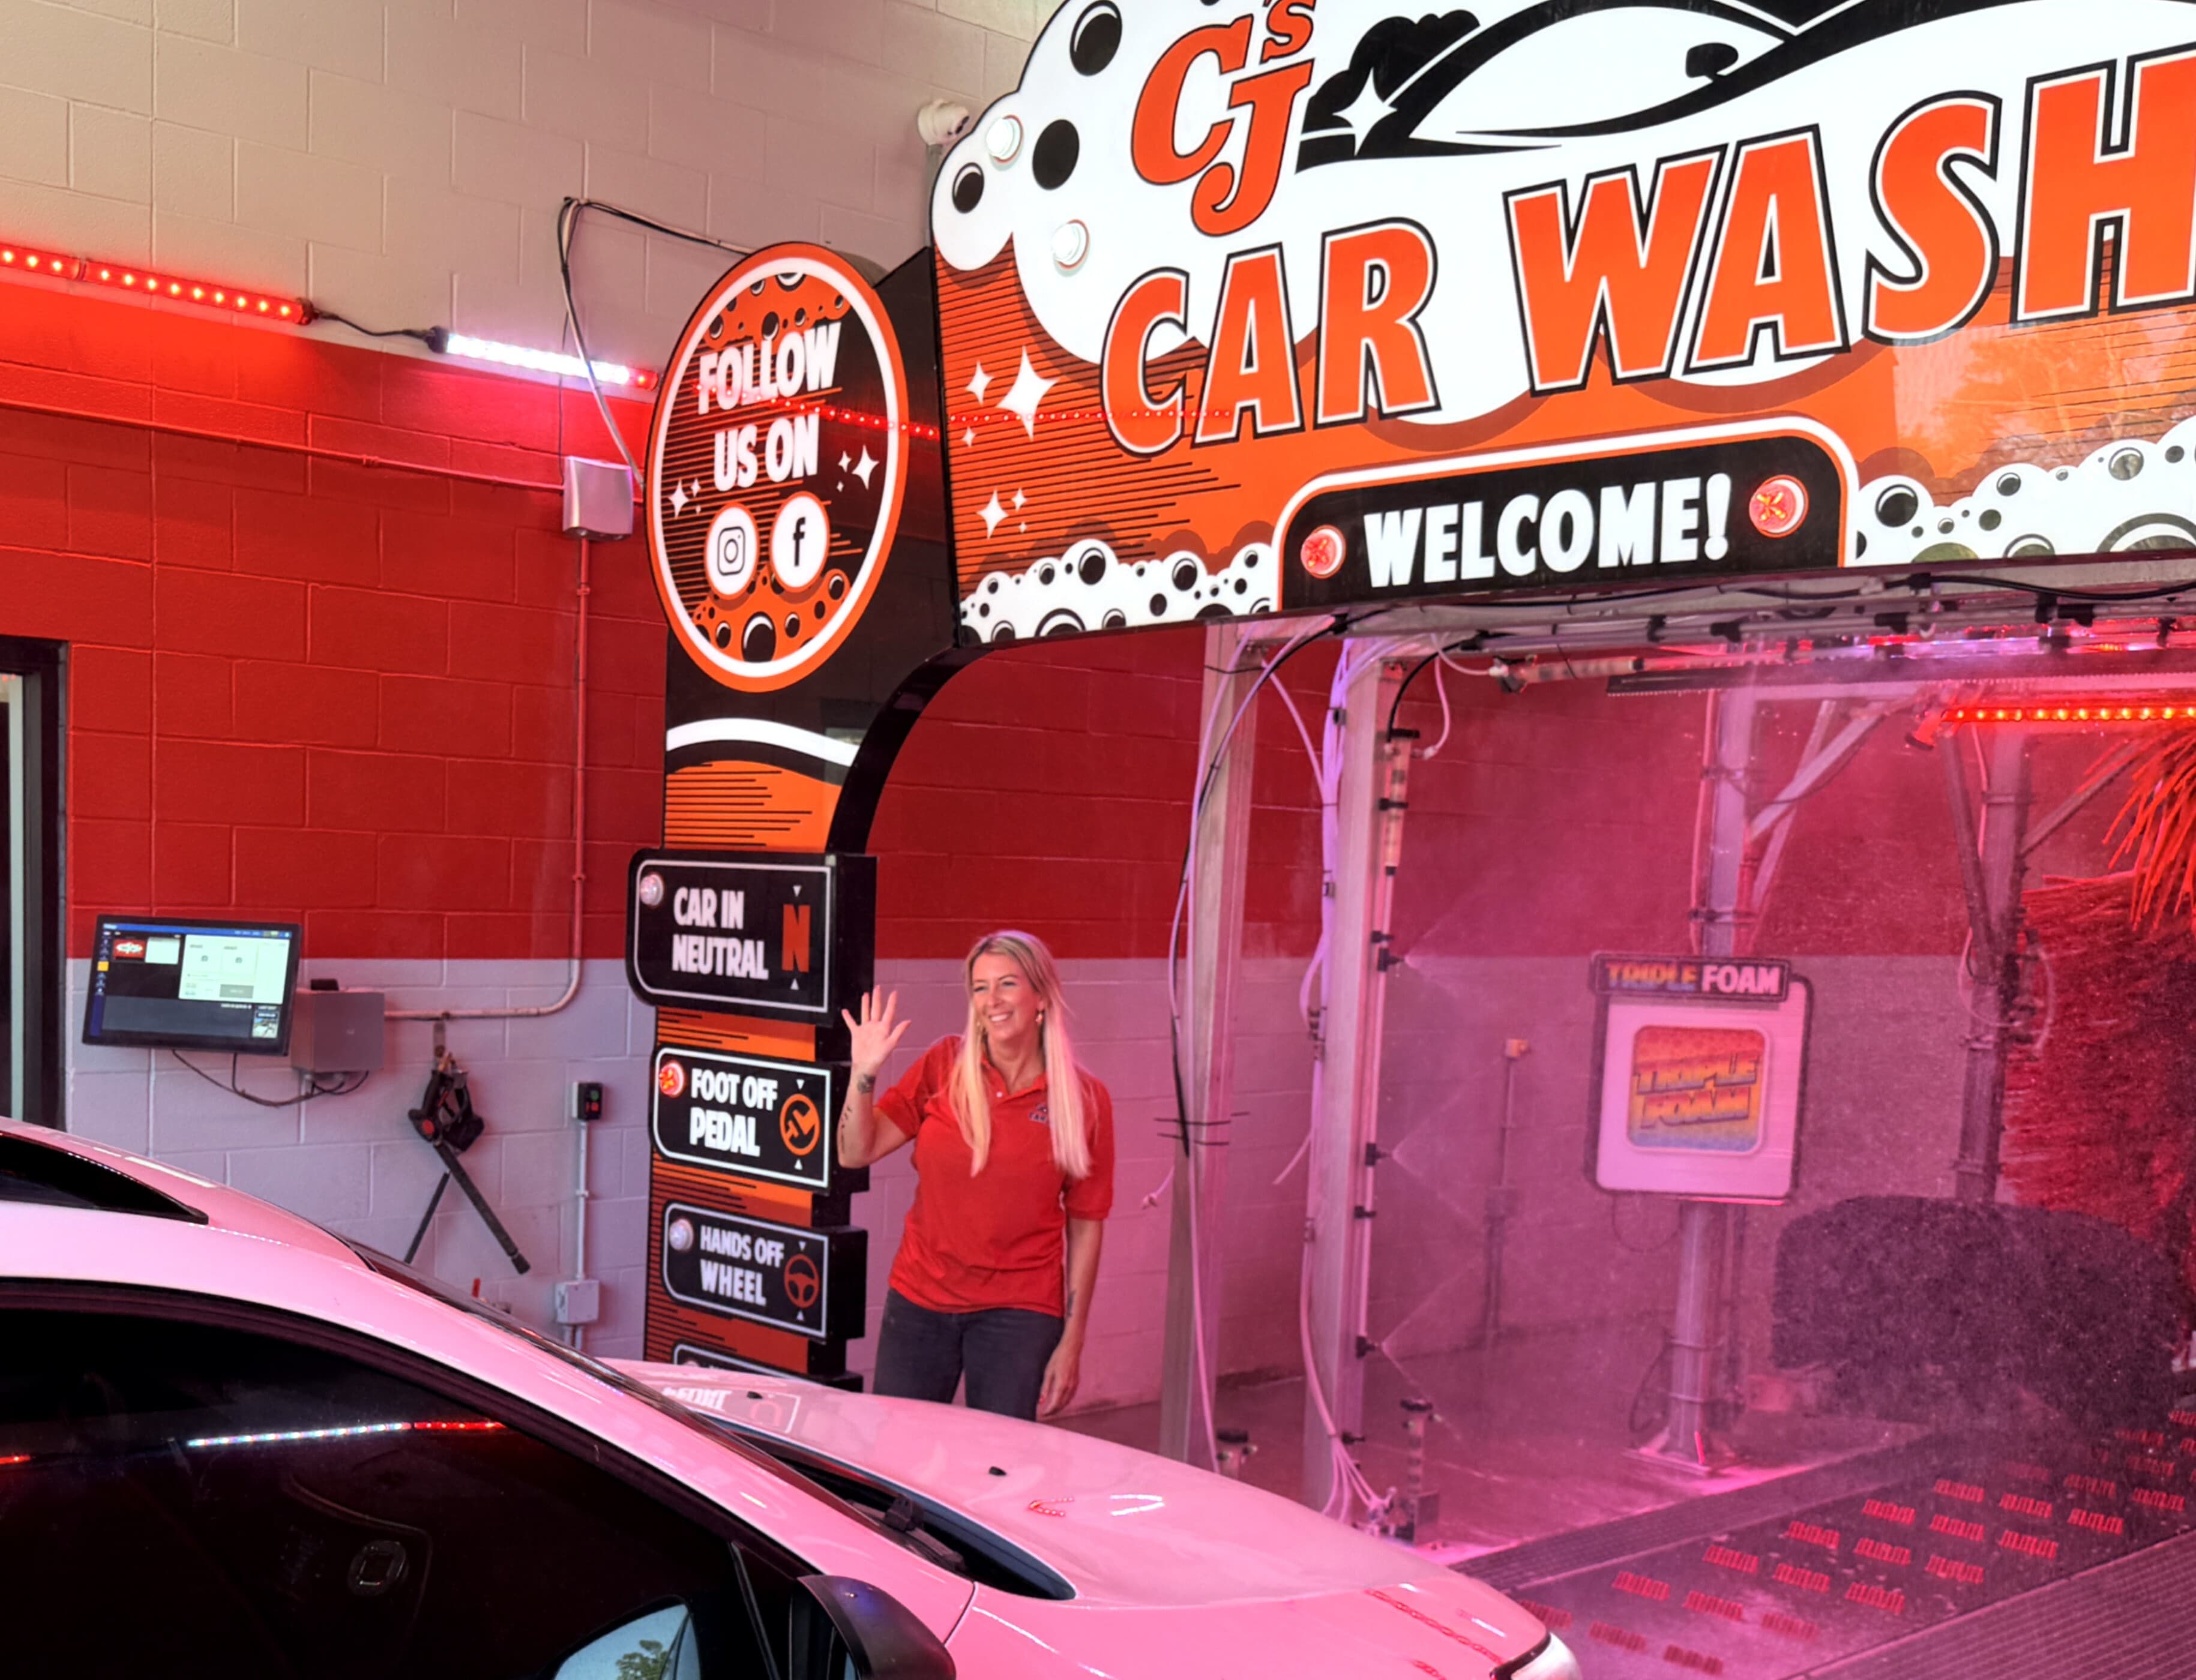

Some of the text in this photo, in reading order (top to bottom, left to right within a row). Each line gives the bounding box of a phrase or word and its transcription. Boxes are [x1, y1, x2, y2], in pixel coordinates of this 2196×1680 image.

[1100, 41, 2196, 458] CAR WASH
[697, 322, 841, 415] FOLLOW
[713, 413, 819, 491] US ON
[1364, 473, 1731, 587] WELCOME!
[673, 886, 744, 930] CAR IN
[672, 934, 769, 980] NEUTRAL
[782, 904, 811, 973] N
[1701, 964, 1781, 994] FOAM
[691, 1068, 778, 1111] FOOT OFF
[689, 1107, 760, 1157] PEDAL
[700, 1225, 784, 1268] HANDS OFF
[700, 1260, 766, 1306] WHEEL
